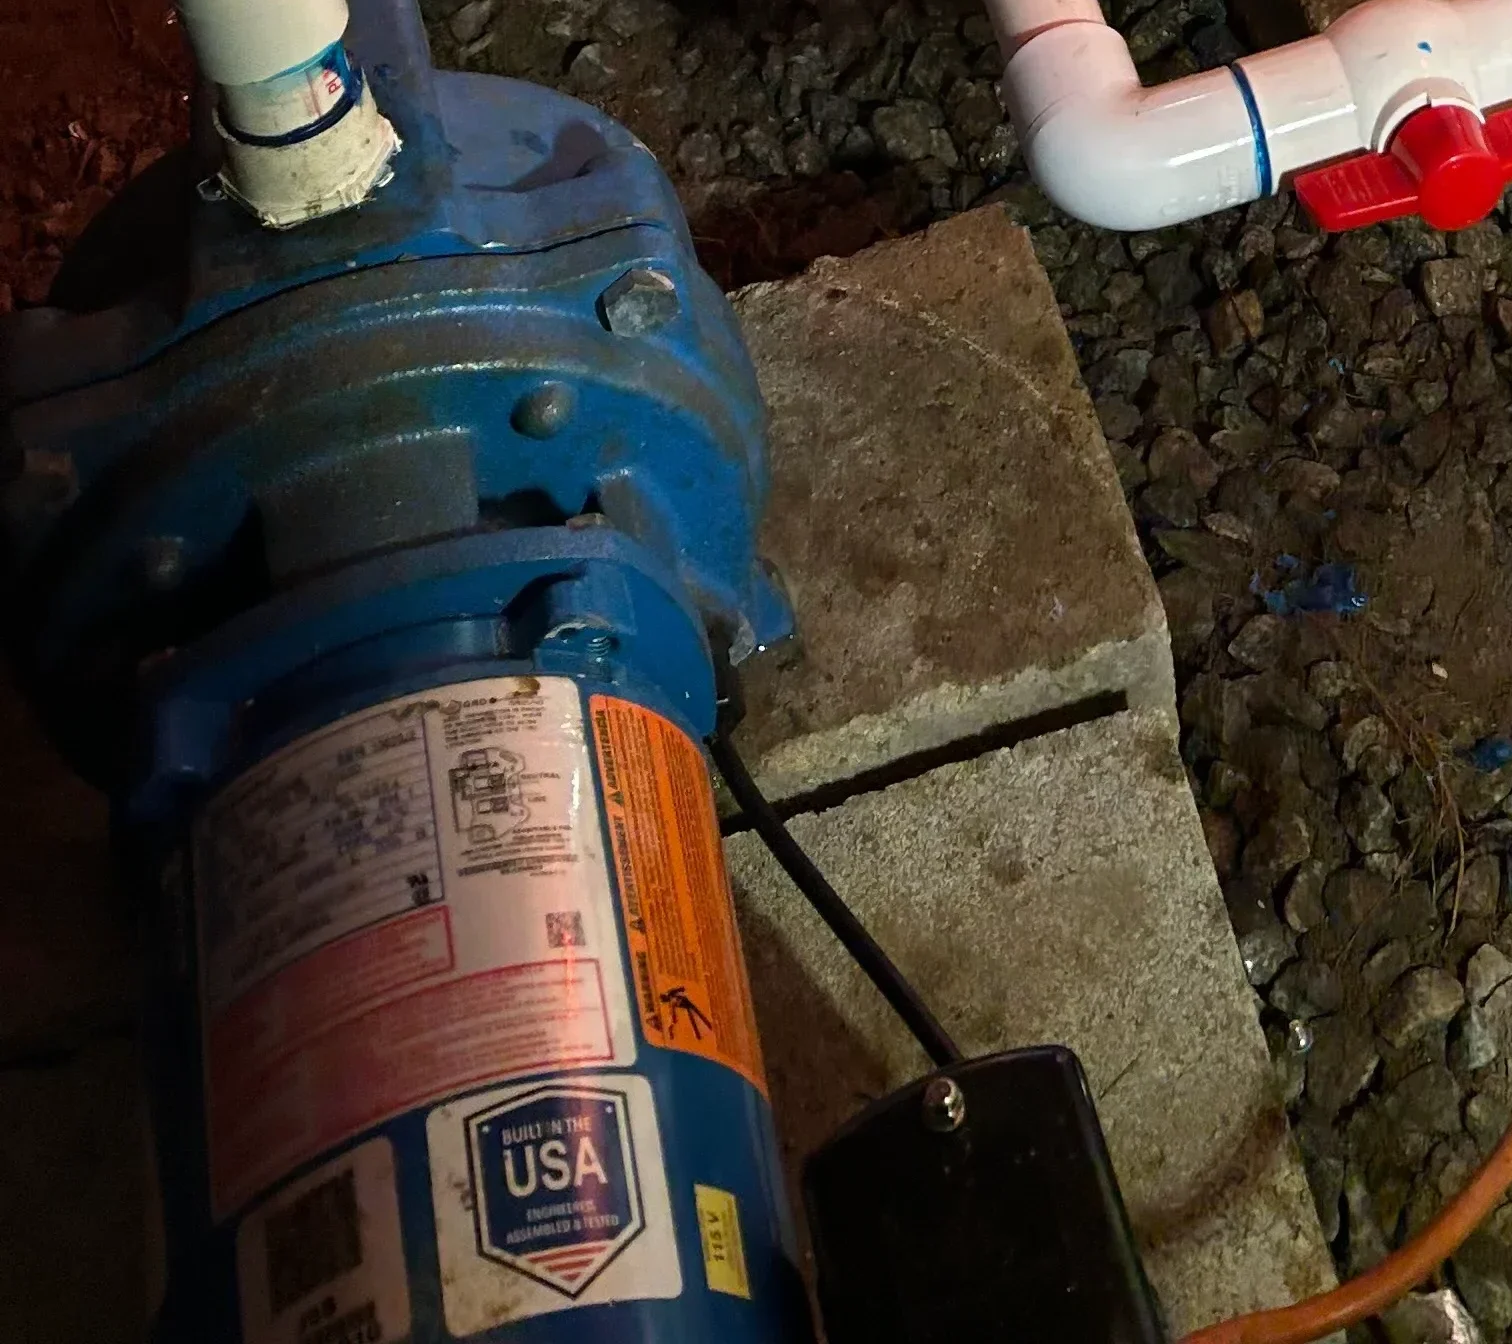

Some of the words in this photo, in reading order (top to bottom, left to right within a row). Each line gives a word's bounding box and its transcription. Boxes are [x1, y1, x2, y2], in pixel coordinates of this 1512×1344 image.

[501, 1122, 544, 1146] BUILT
[566, 1116, 593, 1134] THE
[502, 1136, 608, 1198] USA
